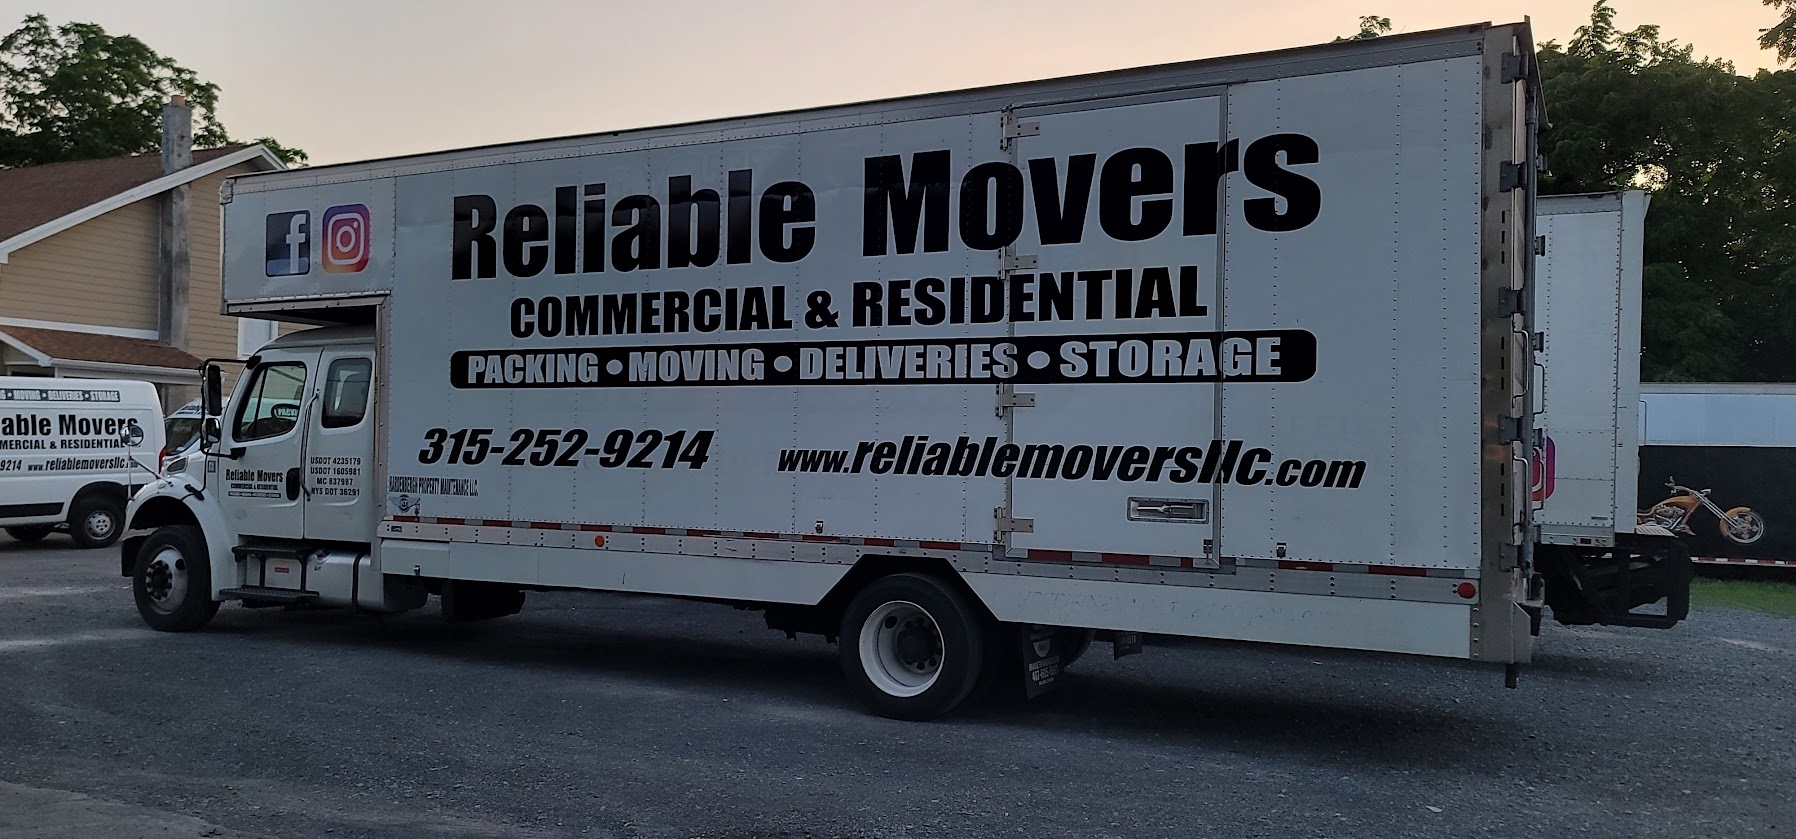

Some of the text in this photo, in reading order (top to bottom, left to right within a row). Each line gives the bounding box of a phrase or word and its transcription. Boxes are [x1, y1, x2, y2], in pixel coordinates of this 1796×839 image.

[452, 132, 1322, 281] Reliable Movers
[511, 265, 1208, 339] COMMERCIAL & RESIDENTIAL
[467, 337, 1283, 384] PACKING MOVING DELIVERIES STORAGE
[13, 389, 41, 400] MOVING
[48, 390, 84, 400] DELIVERIES
[90, 391, 119, 401] STORAGE
[1, 414, 51, 436] able
[49, 440, 57, 450] &
[310, 456, 361, 465] USDOT 4235179
[418, 427, 1367, 489] 315-252-9214 www.reliablemoversllc.com
[226, 469, 283, 482] Reliable Movers
[310, 466, 331, 475] USDOT
[316, 477, 328, 485] MC
[324, 487, 338, 496] DOT
[339, 488, 360, 496] 36291
